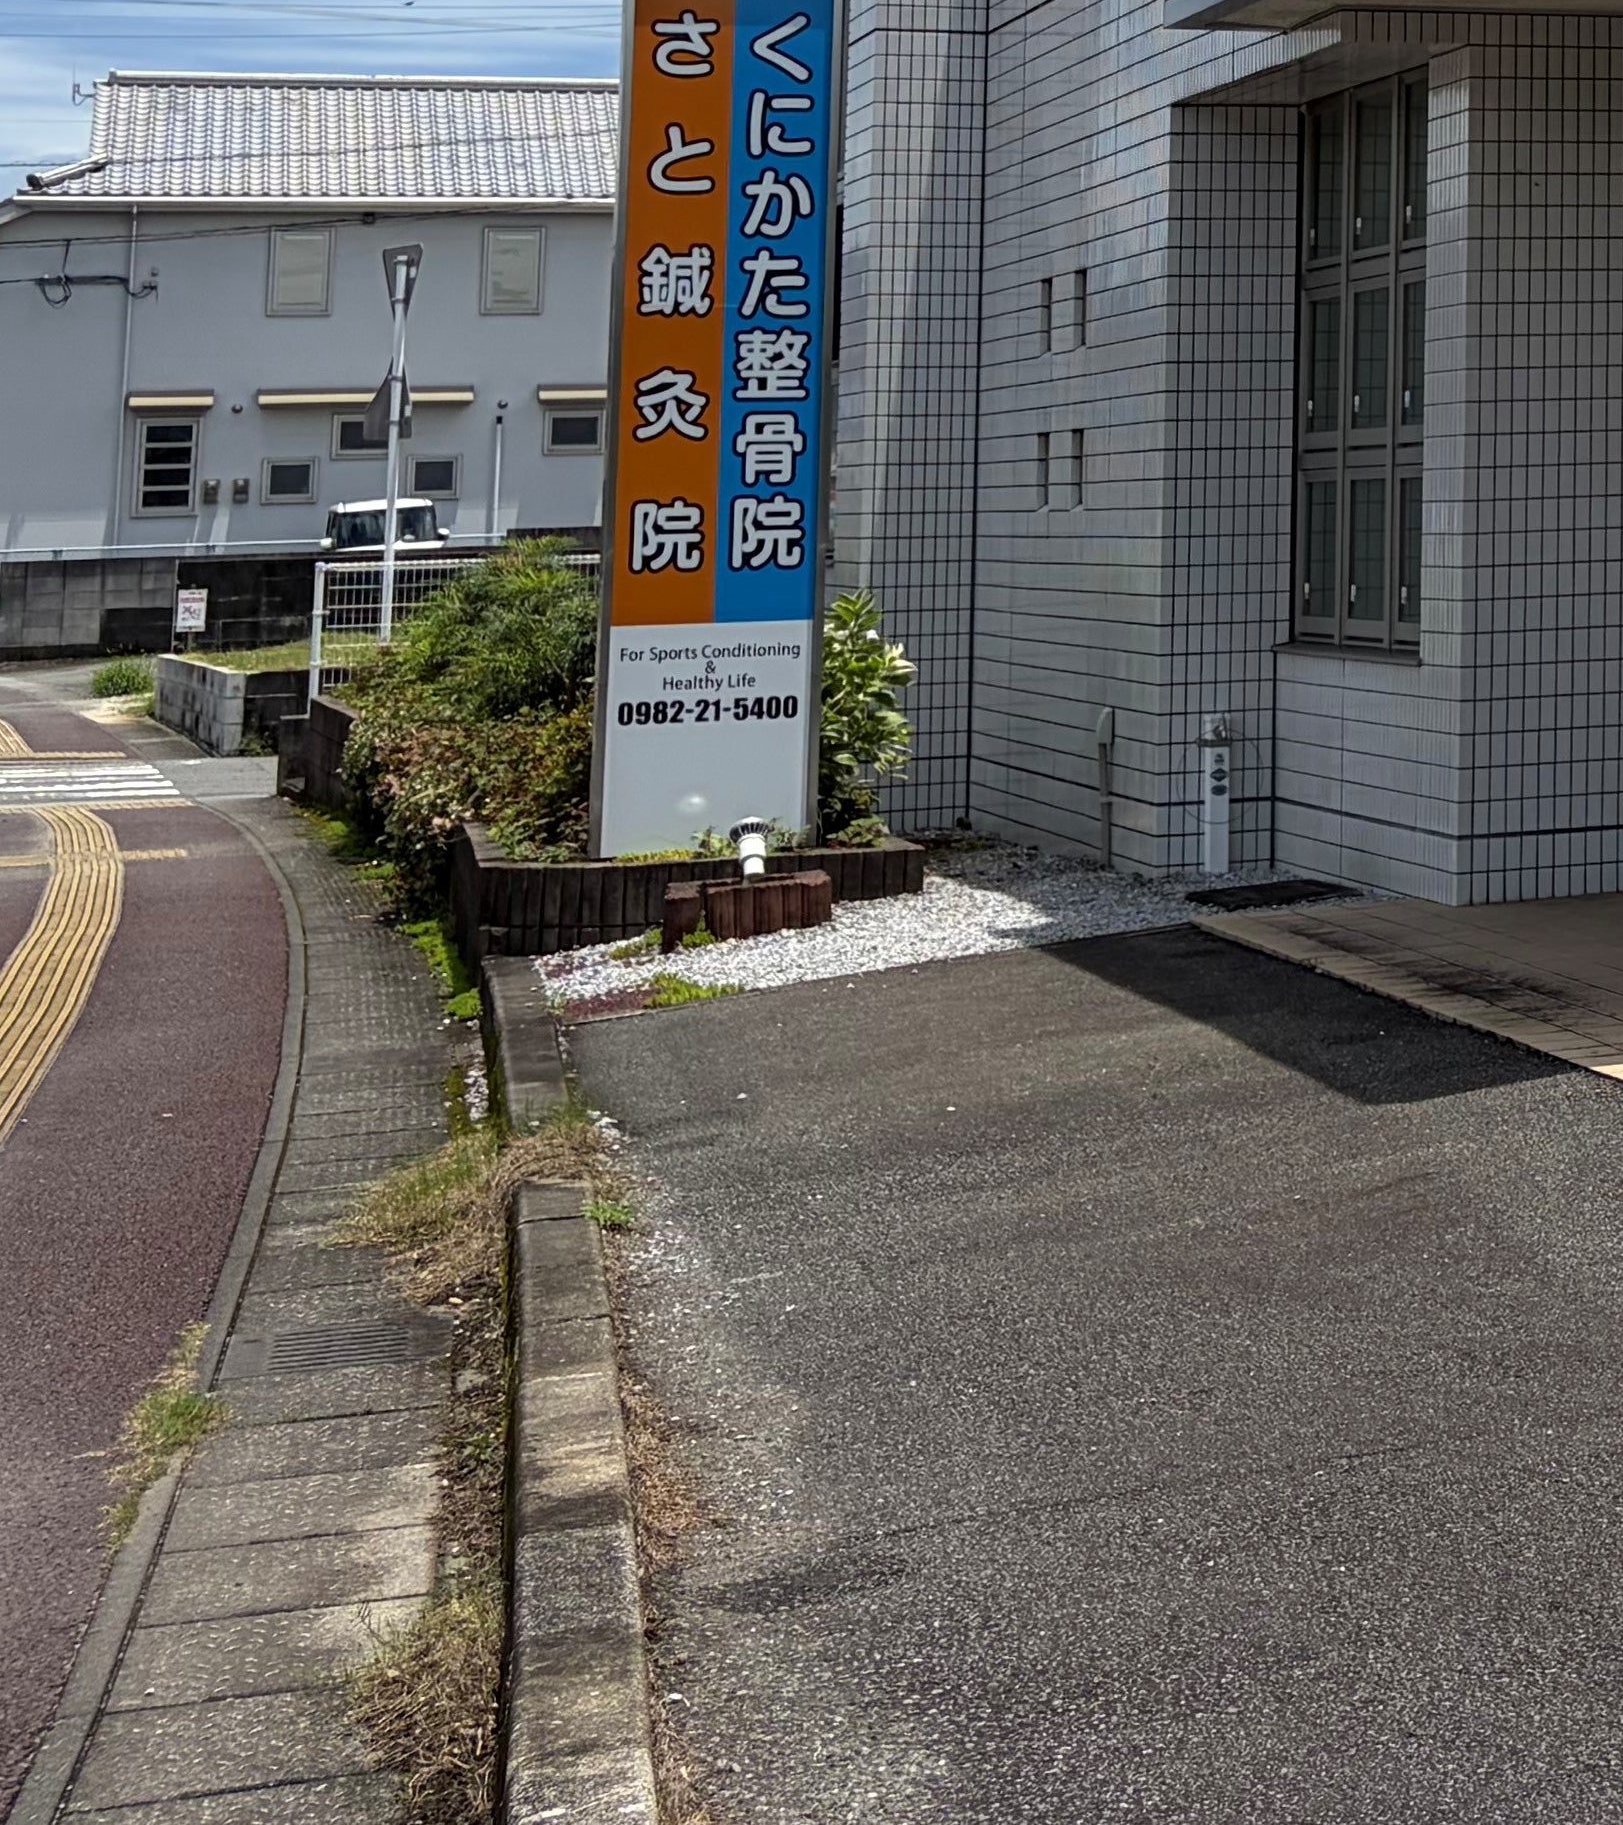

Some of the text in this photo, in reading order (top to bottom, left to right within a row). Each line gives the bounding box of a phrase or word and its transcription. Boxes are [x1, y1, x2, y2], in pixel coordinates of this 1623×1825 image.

[631, 11, 719, 571] さと鍼灸院
[731, 14, 812, 569] くにかた整骨院
[620, 642, 801, 664] For Sports Conditioning
[704, 660, 717, 674] &
[662, 673, 756, 692] Healthy Life
[617, 695, 798, 726] 0982-21-5400
